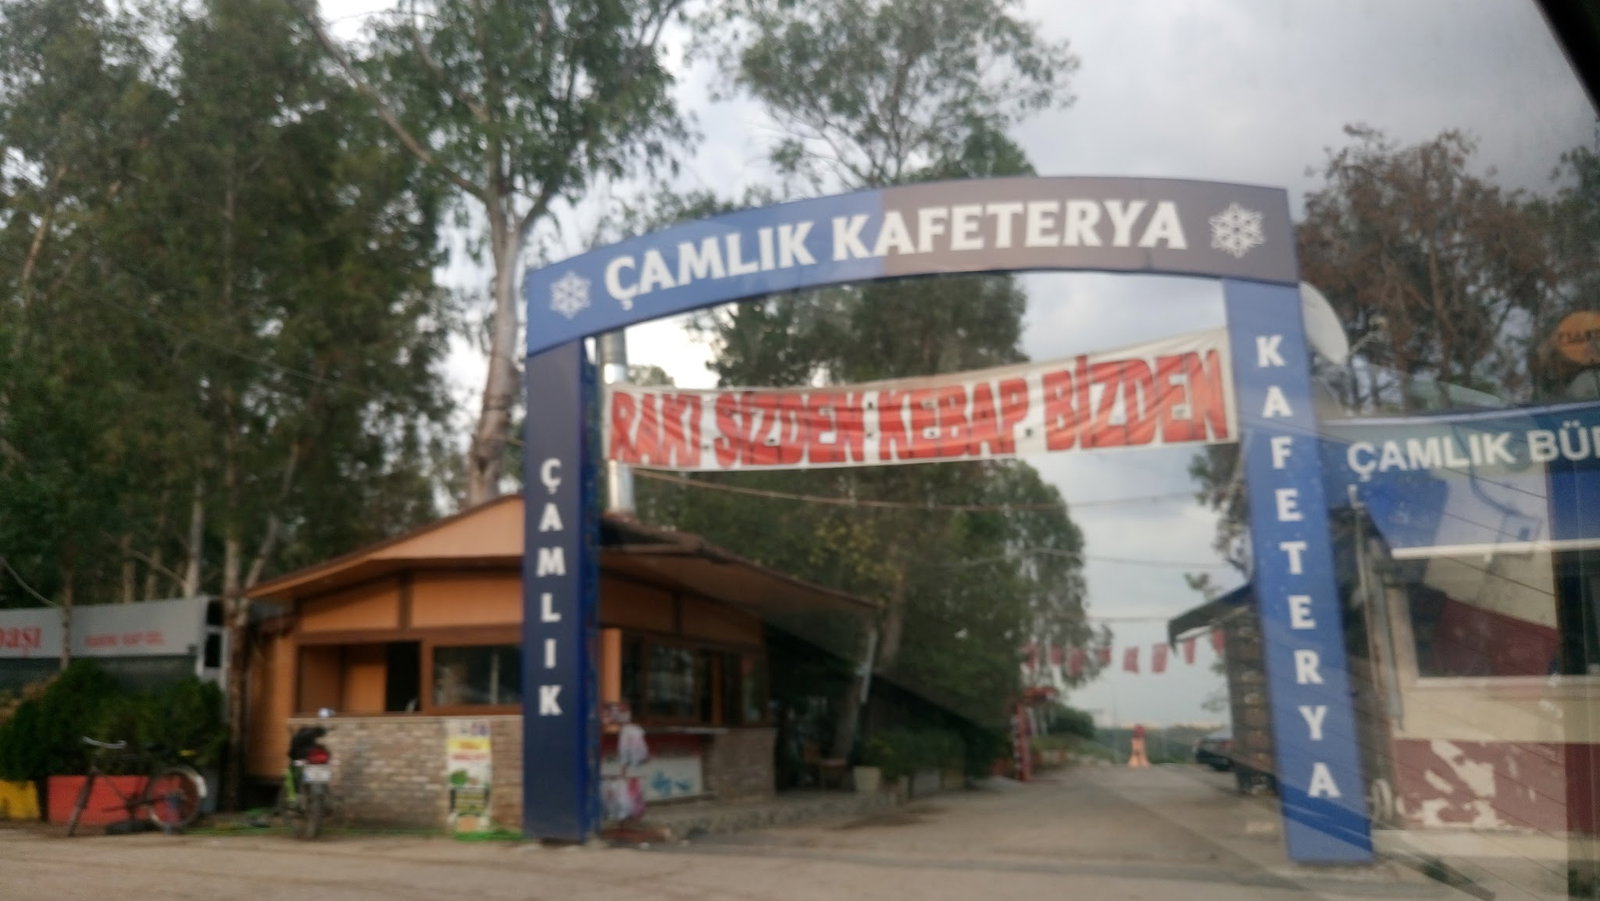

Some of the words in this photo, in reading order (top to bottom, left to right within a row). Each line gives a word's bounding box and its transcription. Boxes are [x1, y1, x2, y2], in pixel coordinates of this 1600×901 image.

[604, 221, 817, 311] ÇAMLIK
[831, 199, 1189, 262] KAFETERYA
[1347, 431, 1517, 482] ÇAMLIK
[536, 458, 567, 716] ÇAMLIK
[1255, 335, 1341, 799] KAFETERYA
